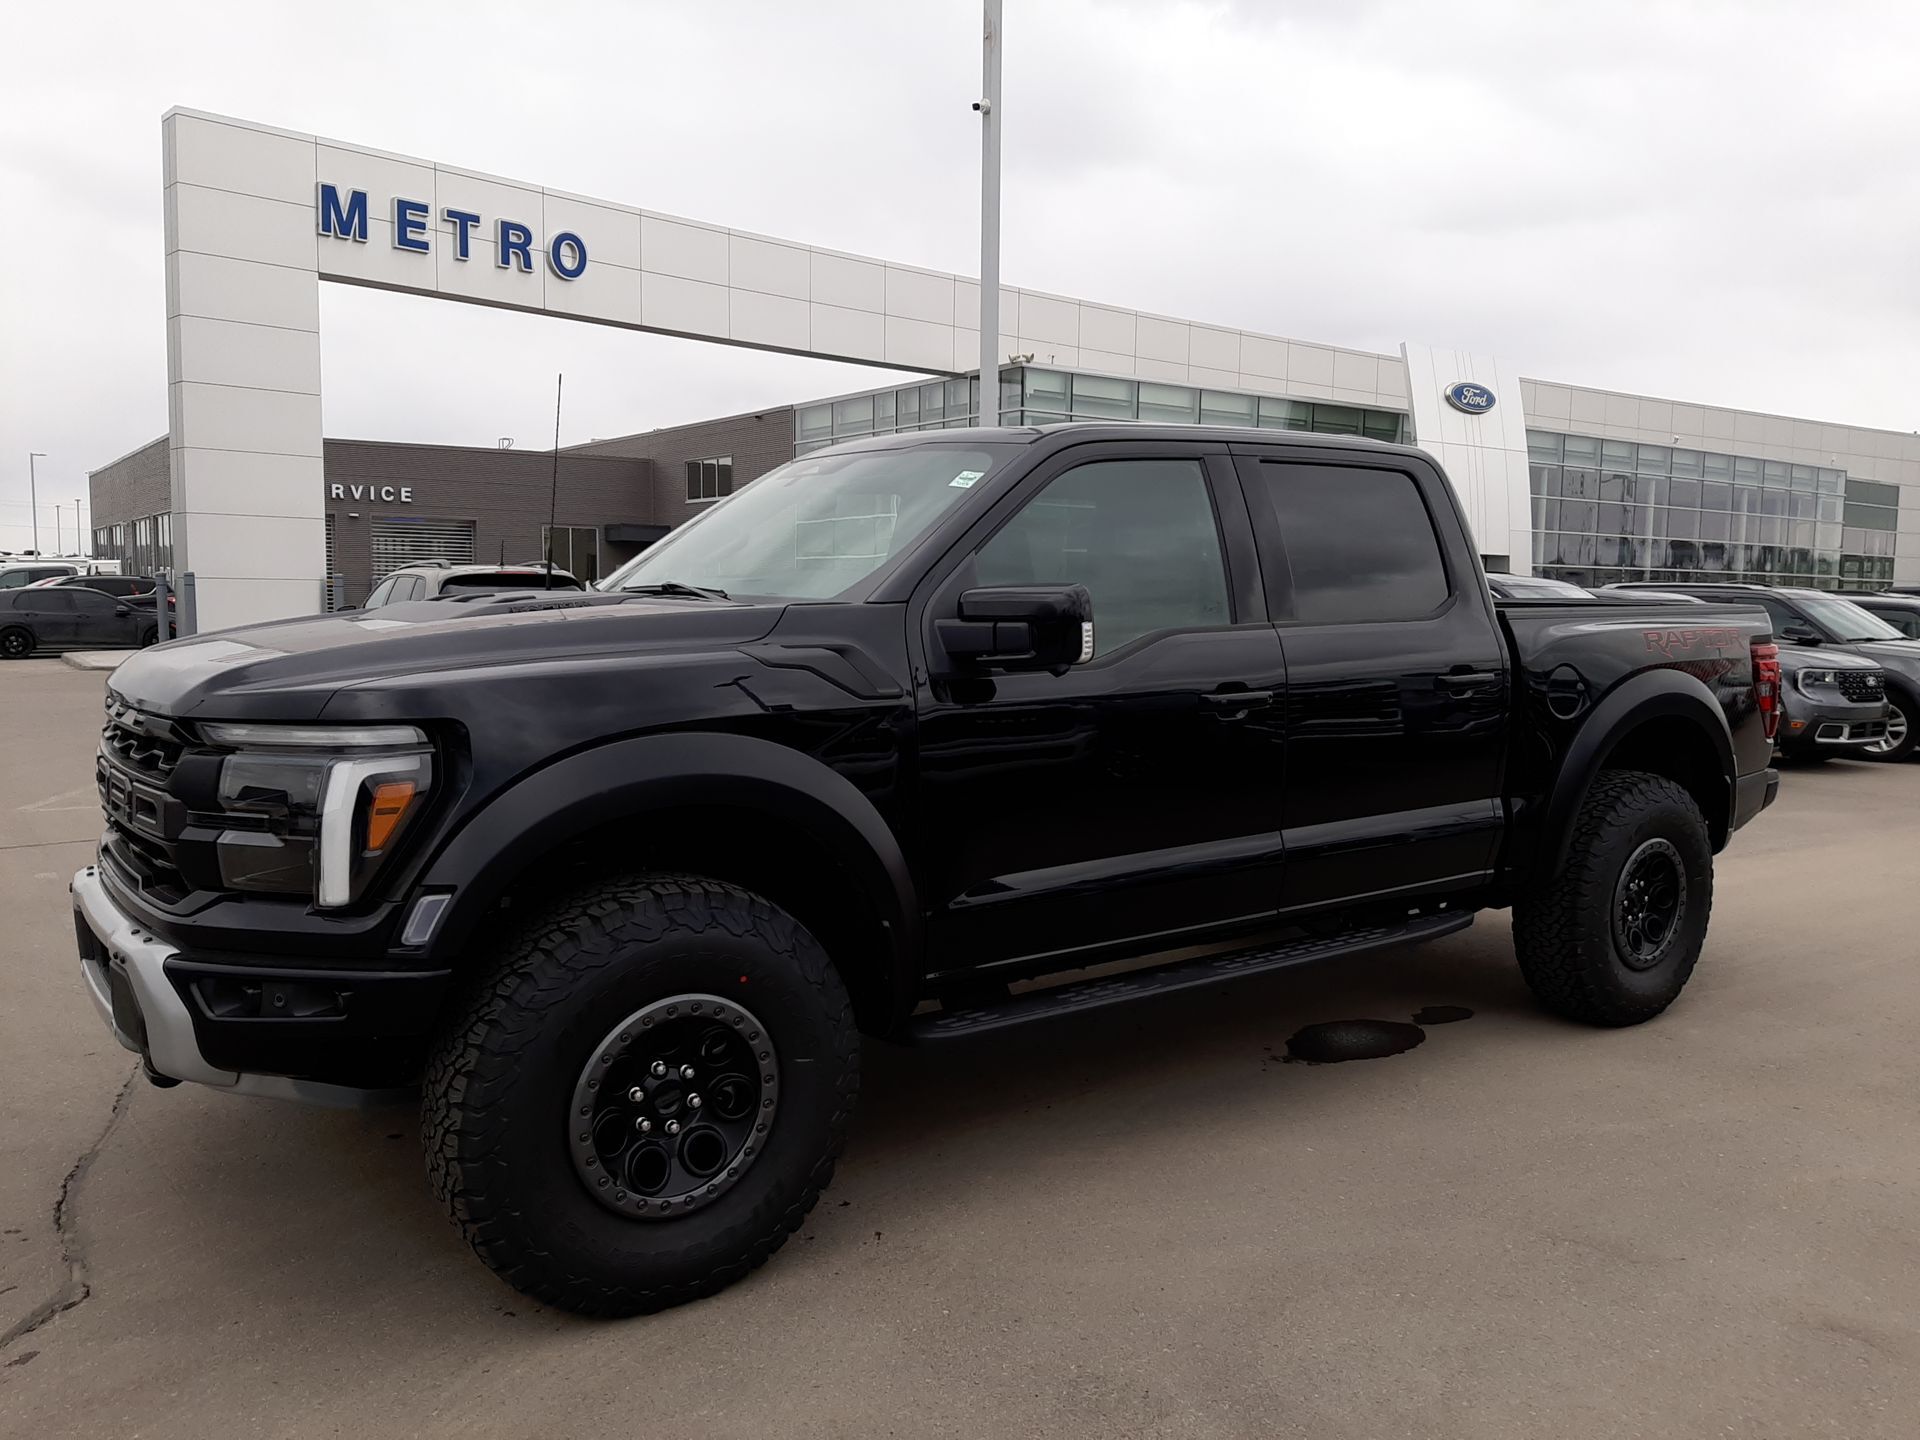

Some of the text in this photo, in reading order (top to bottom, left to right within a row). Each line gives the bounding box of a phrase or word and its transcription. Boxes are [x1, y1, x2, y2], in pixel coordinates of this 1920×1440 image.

[317, 181, 588, 281] METRO
[1461, 387, 1488, 406] Ford
[331, 483, 412, 502] RVICE
[1642, 627, 1745, 659] RAPTOR
